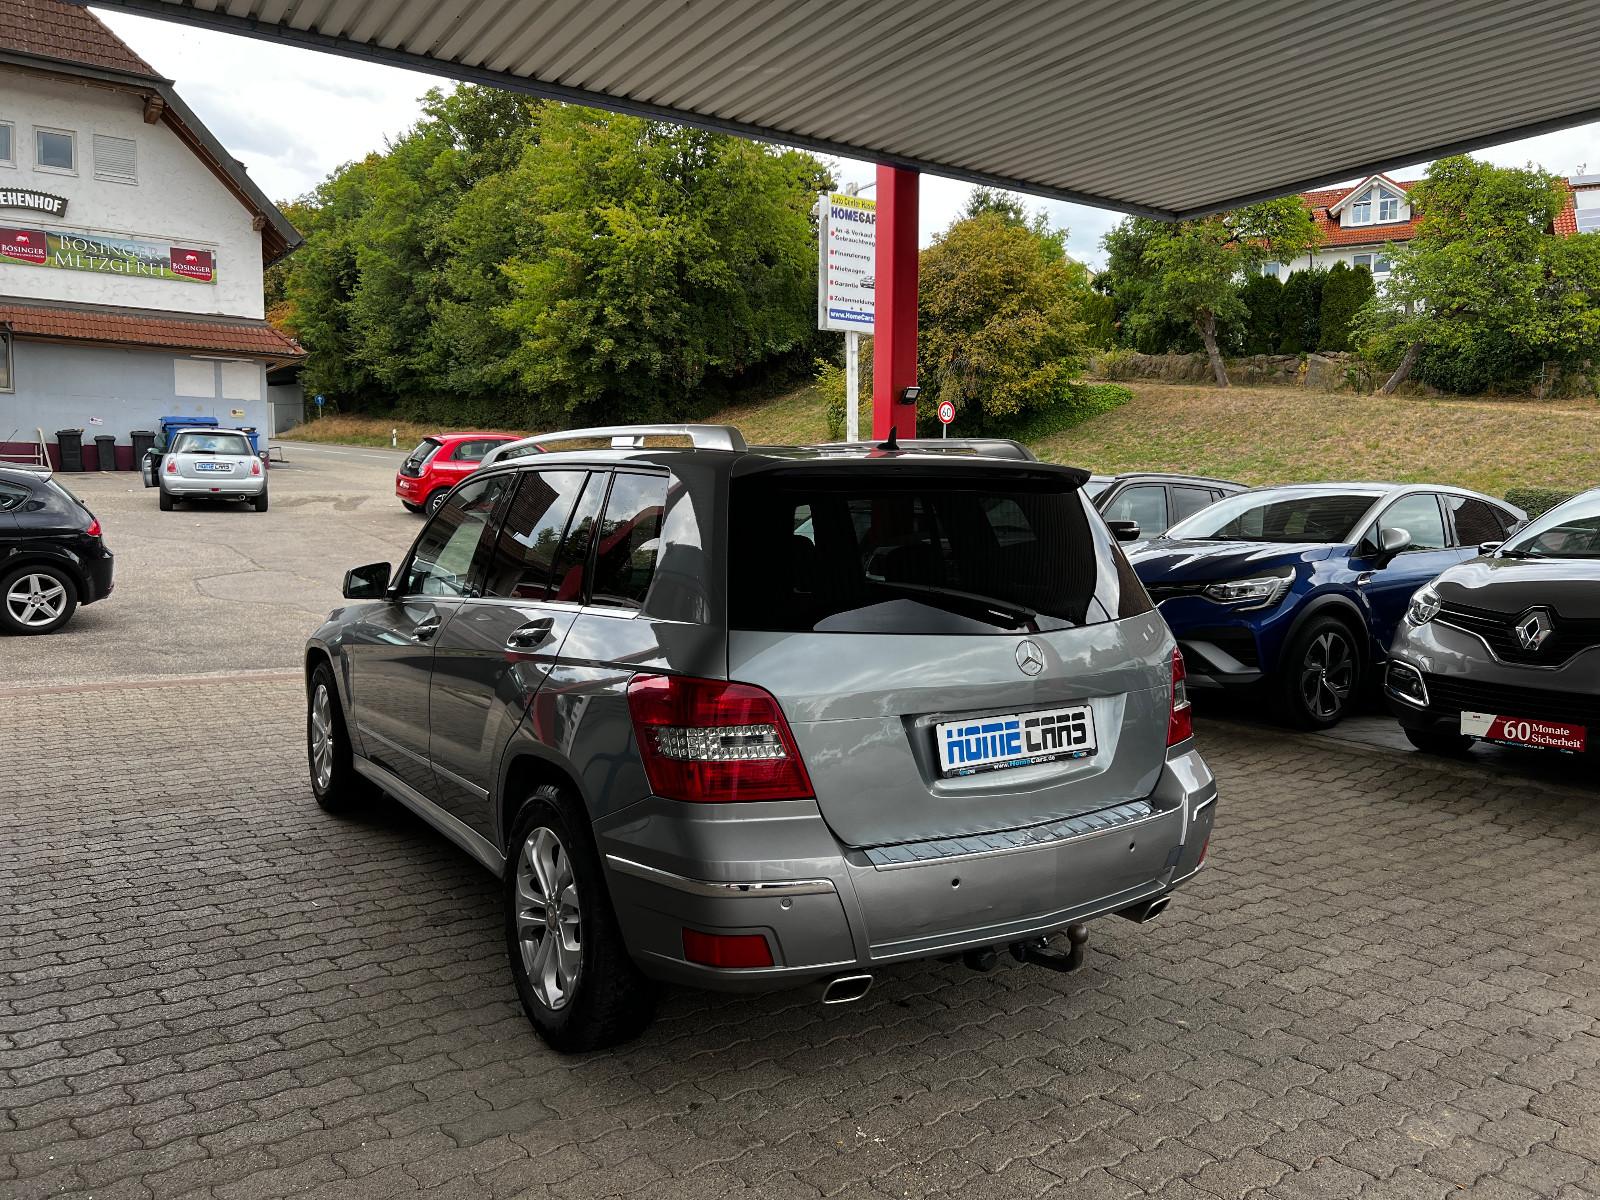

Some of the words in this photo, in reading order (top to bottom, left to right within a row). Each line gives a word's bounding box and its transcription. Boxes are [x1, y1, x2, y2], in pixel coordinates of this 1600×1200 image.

[55, 251, 164, 277] METZGEREI
[834, 280, 859, 289] Garantie
[946, 720, 1022, 764] HOME
[1024, 711, 1087, 752] CARS
[1503, 720, 1531, 741] 60
[1531, 723, 1570, 736] Monate
